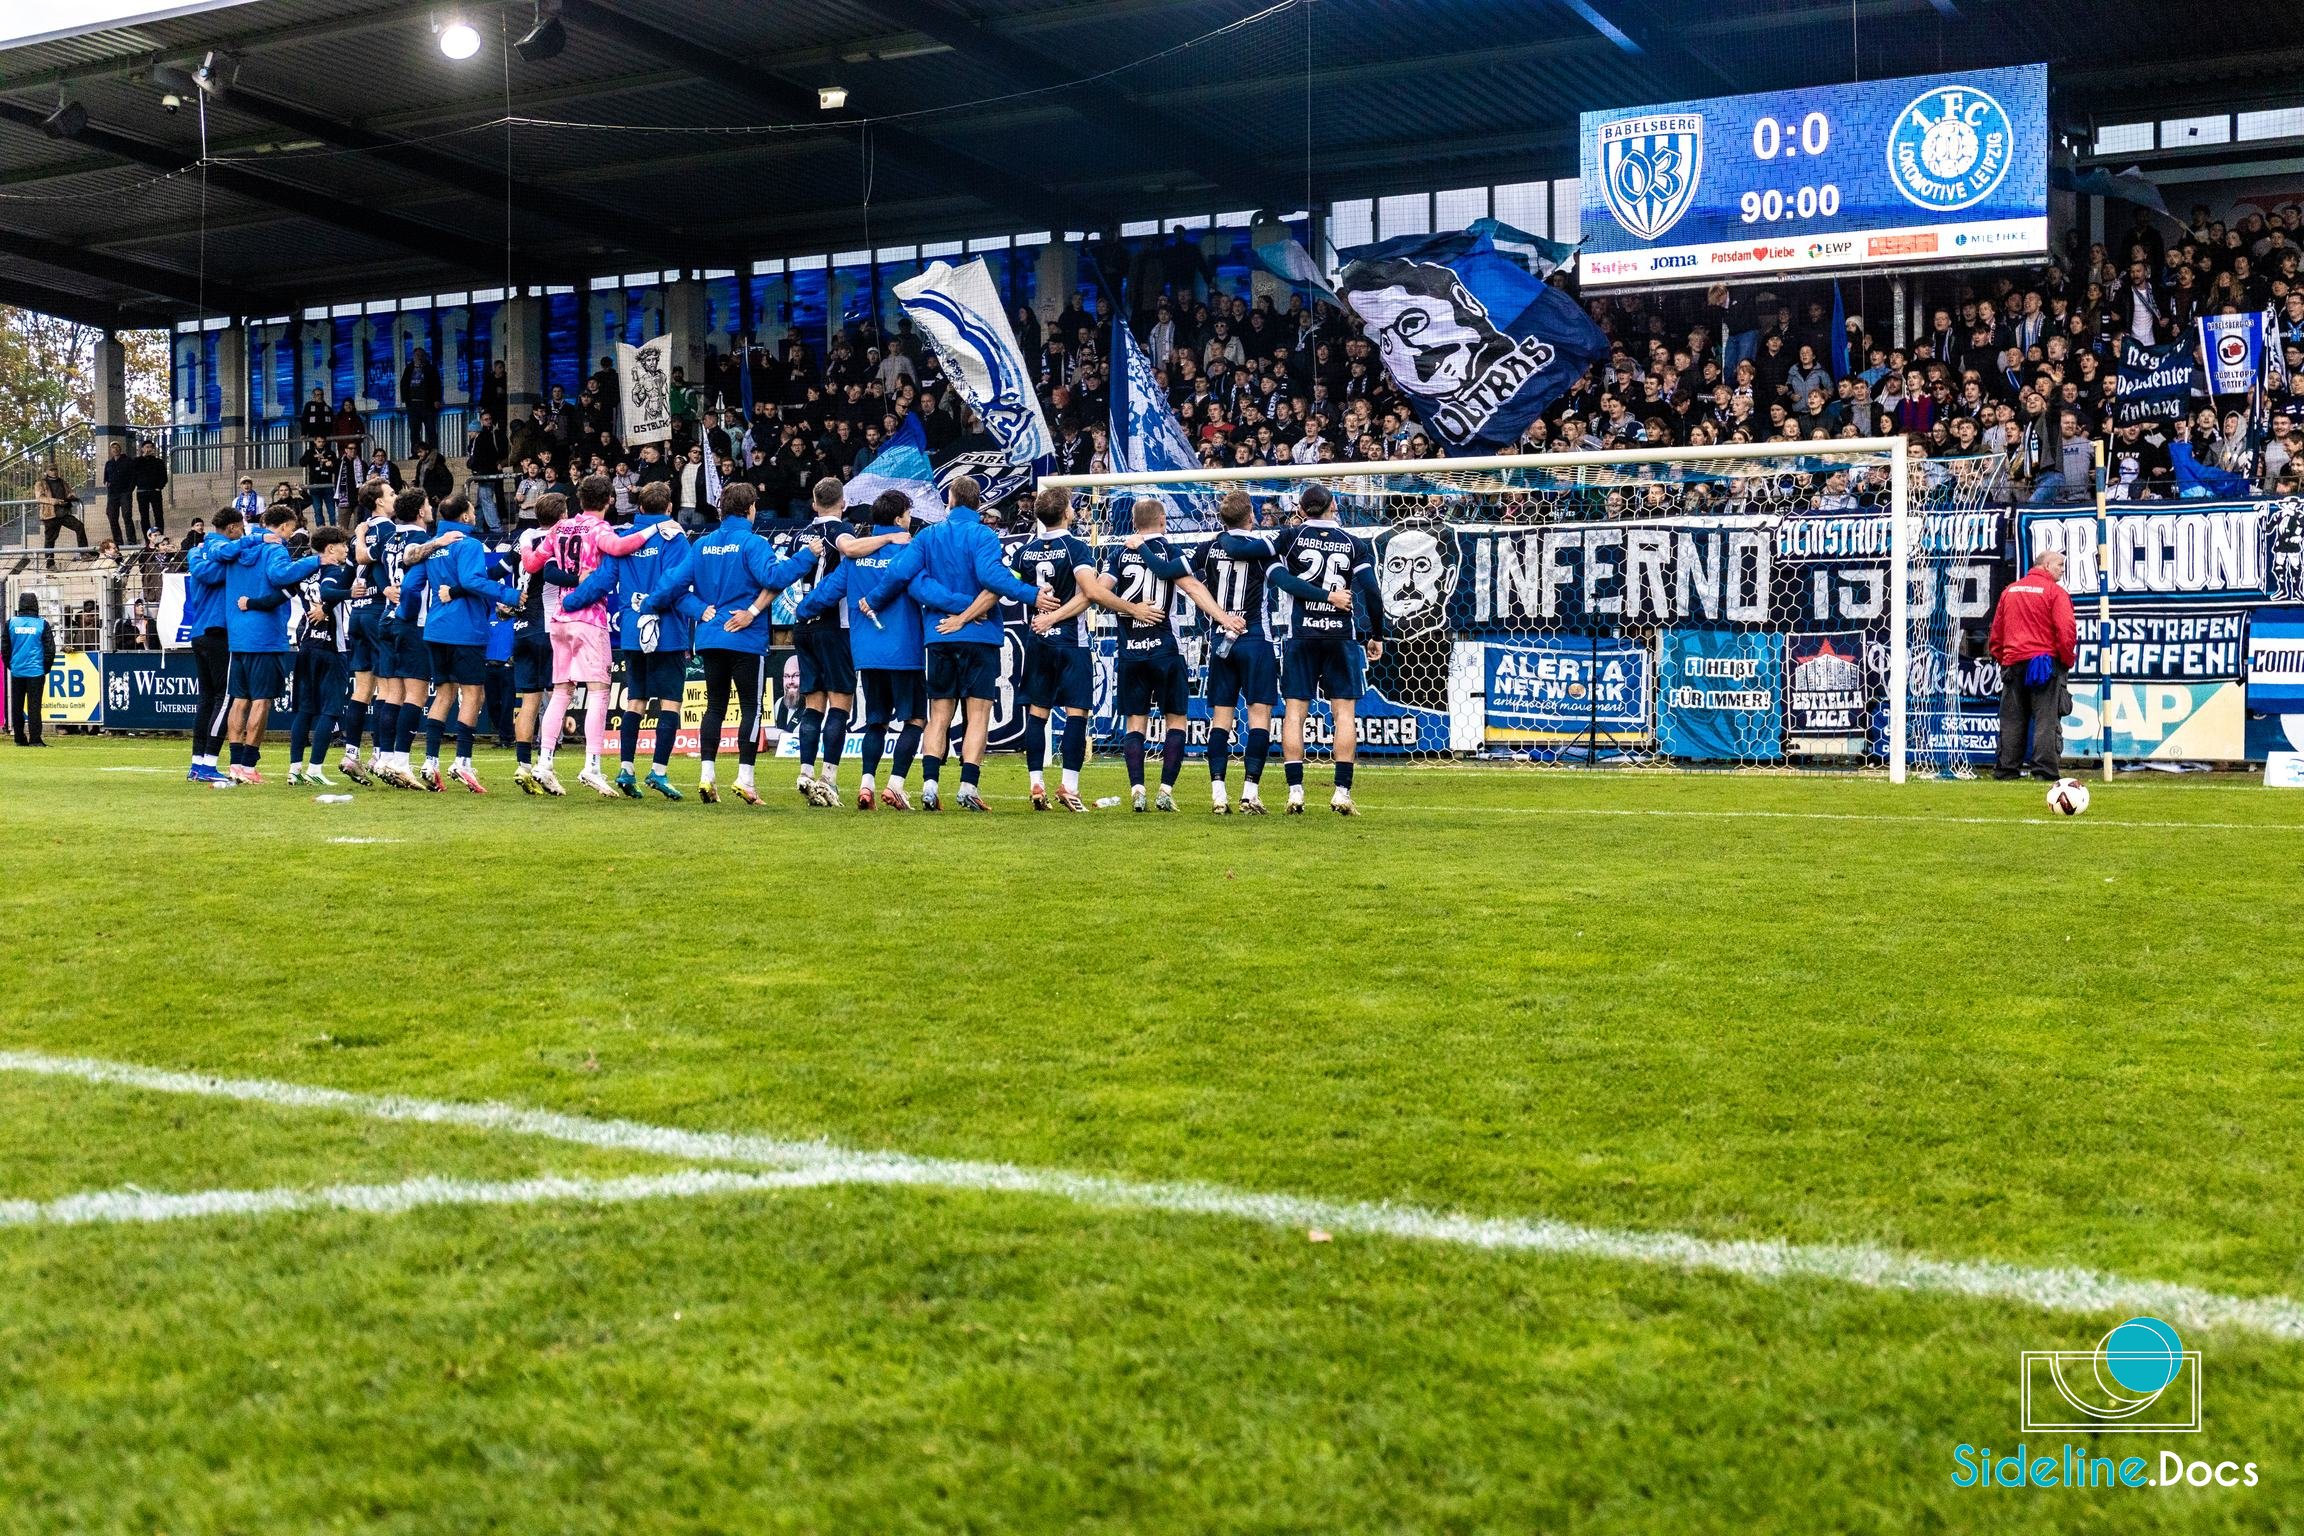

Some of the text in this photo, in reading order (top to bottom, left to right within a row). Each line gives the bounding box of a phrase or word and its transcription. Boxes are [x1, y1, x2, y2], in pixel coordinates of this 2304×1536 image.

[1605, 118, 1696, 139] BABELSBERG
[1752, 111, 1829, 160] 0:0
[1615, 146, 1683, 205] 03
[1898, 132, 2003, 200] LOKOMOTIVE LEIPZIG
[1740, 184, 1840, 223] 90:00
[1591, 260, 1638, 275] Katjes
[1711, 250, 1752, 264] Potsdam
[1769, 246, 1795, 259] Liebe
[1825, 242, 1852, 254] EWP
[1433, 337, 1553, 444] ULTRAS
[2120, 398, 2181, 422] Anhang
[558, 535, 583, 577] 19
[1297, 537, 1352, 553] BABELSBERG
[1297, 549, 1351, 592] 26
[1475, 529, 1770, 622] INFERNO
[1118, 564, 1168, 618] 20
[1216, 560, 1249, 612] 11
[1302, 616, 1343, 631] Katjes
[2076, 616, 2239, 641] ANDSSTRAFEN
[1126, 638, 1162, 651] Katjes
[1496, 654, 1625, 682] ALERTA
[133, 670, 200, 696] WESTM
[69, 702, 86, 710] GmbH
[155, 700, 198, 714] UNTERNEH
[1493, 695, 1557, 713] antifascist
[1669, 685, 1771, 710] FÜR IMMER!
[1792, 690, 1864, 711] ESTRELLA
[1805, 710, 1850, 727] LOCA
[2060, 683, 2194, 741] SAP
